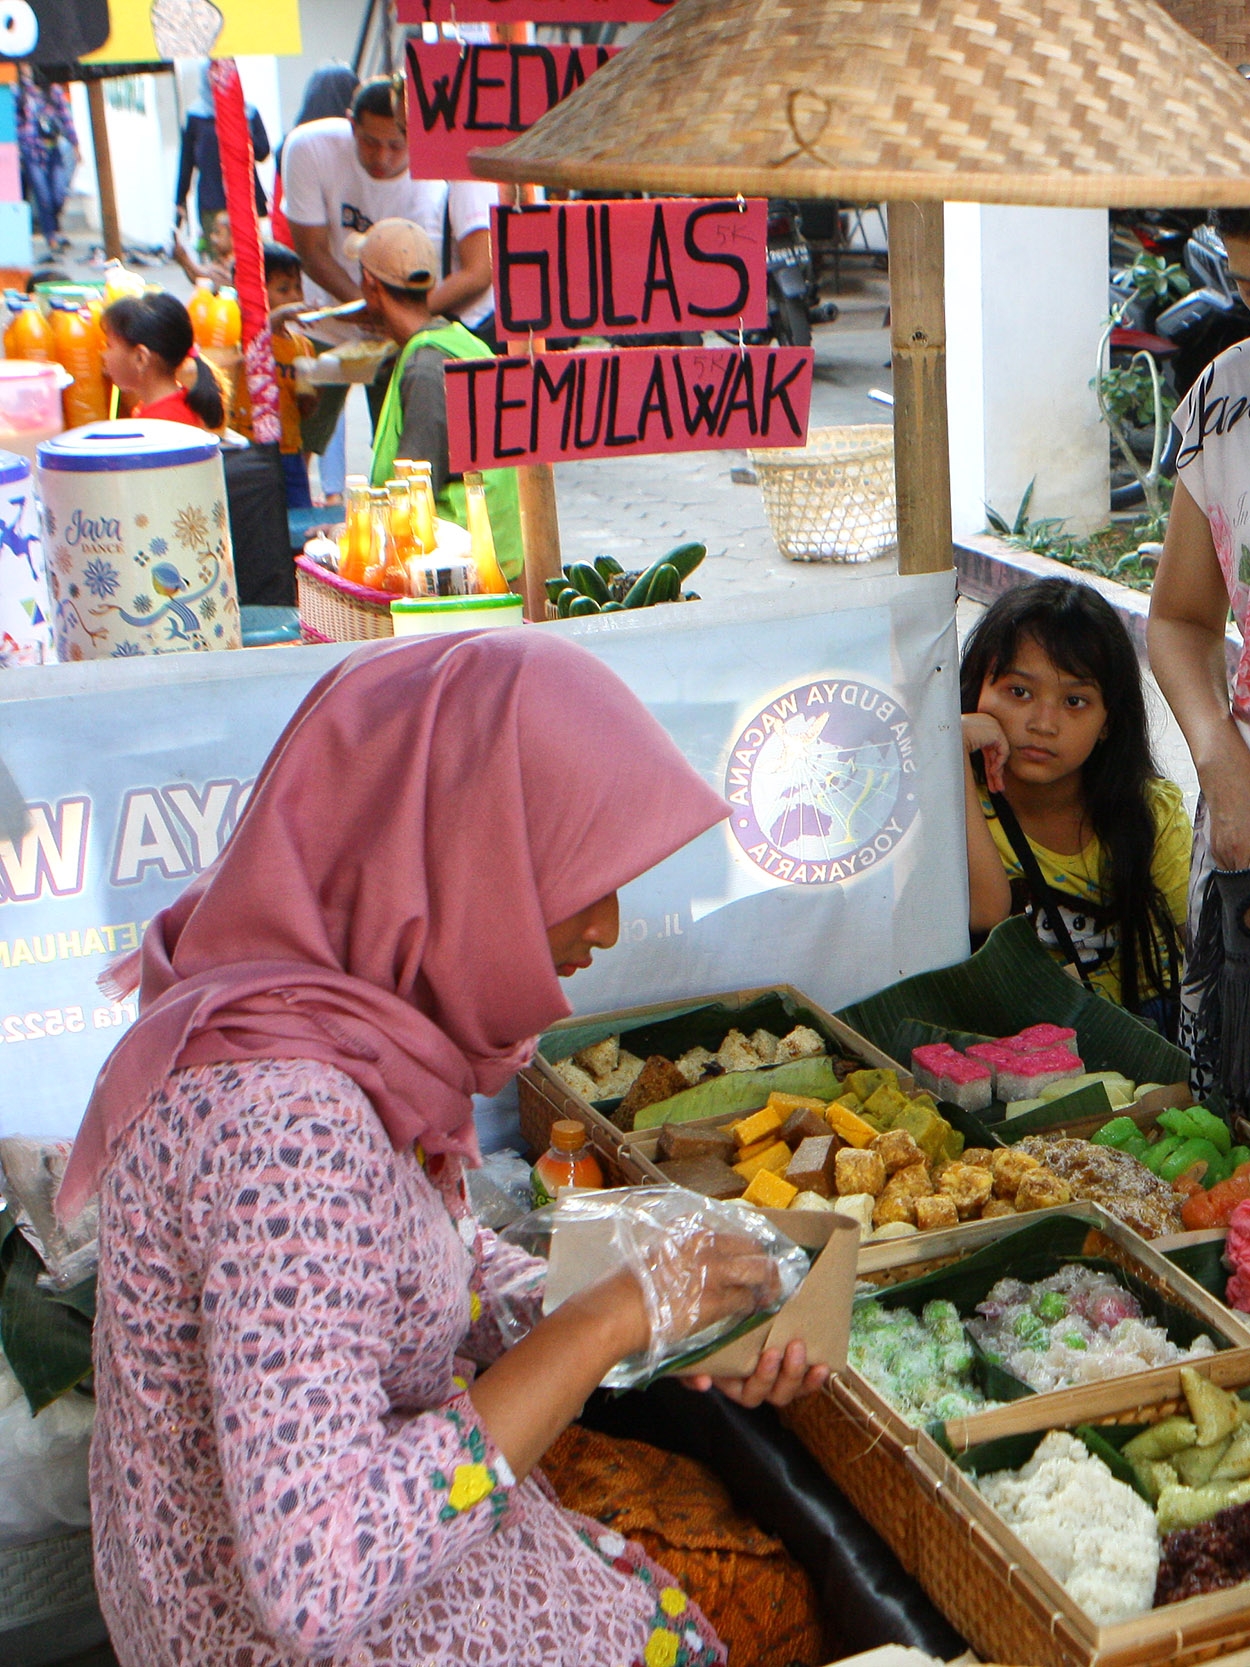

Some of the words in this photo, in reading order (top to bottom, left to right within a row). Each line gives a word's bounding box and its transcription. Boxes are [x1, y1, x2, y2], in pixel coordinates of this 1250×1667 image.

[406, 42, 609, 131] WEDA
[497, 202, 750, 332] GULAS
[445, 352, 807, 462] TEMULAWAK
[65, 509, 123, 546] Java
